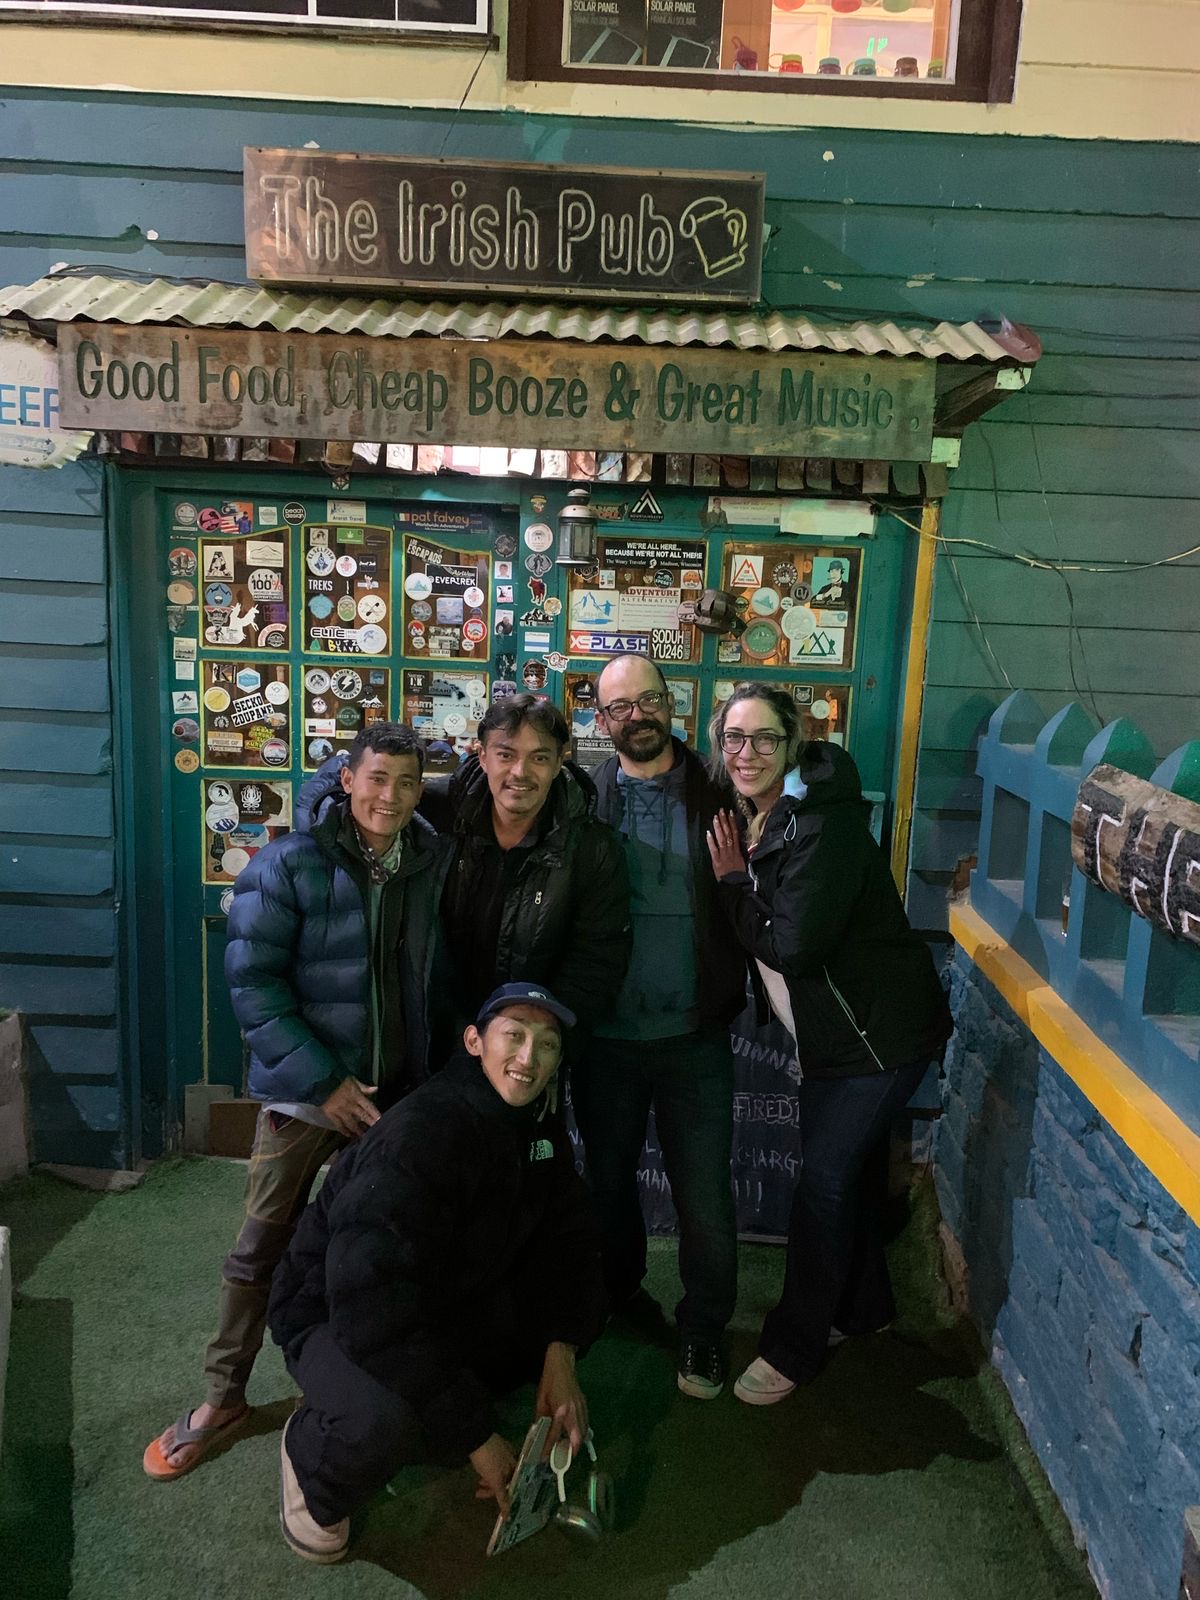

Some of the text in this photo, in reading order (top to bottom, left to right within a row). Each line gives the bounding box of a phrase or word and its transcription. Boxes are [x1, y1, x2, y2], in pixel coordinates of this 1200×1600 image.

[573, 0, 619, 14] SOLAR PANEL
[651, 1, 696, 14] SOLAR PANEL
[260, 174, 674, 277] The Irish Pub
[76, 340, 180, 402] Good
[328, 348, 449, 431] Cheap
[468, 357, 589, 418] Booze
[603, 361, 641, 421] &
[656, 363, 760, 425] Great
[411, 511, 431, 524] pat
[433, 511, 470, 527] falvey
[251, 580, 282, 590] 100%
[308, 579, 333, 591] TREKS
[623, 588, 679, 597] ADVENTURE
[311, 629, 345, 638] ELITE
[652, 629, 684, 644] SODUH
[652, 643, 683, 660] YU246
[234, 695, 263, 713] SECKO
